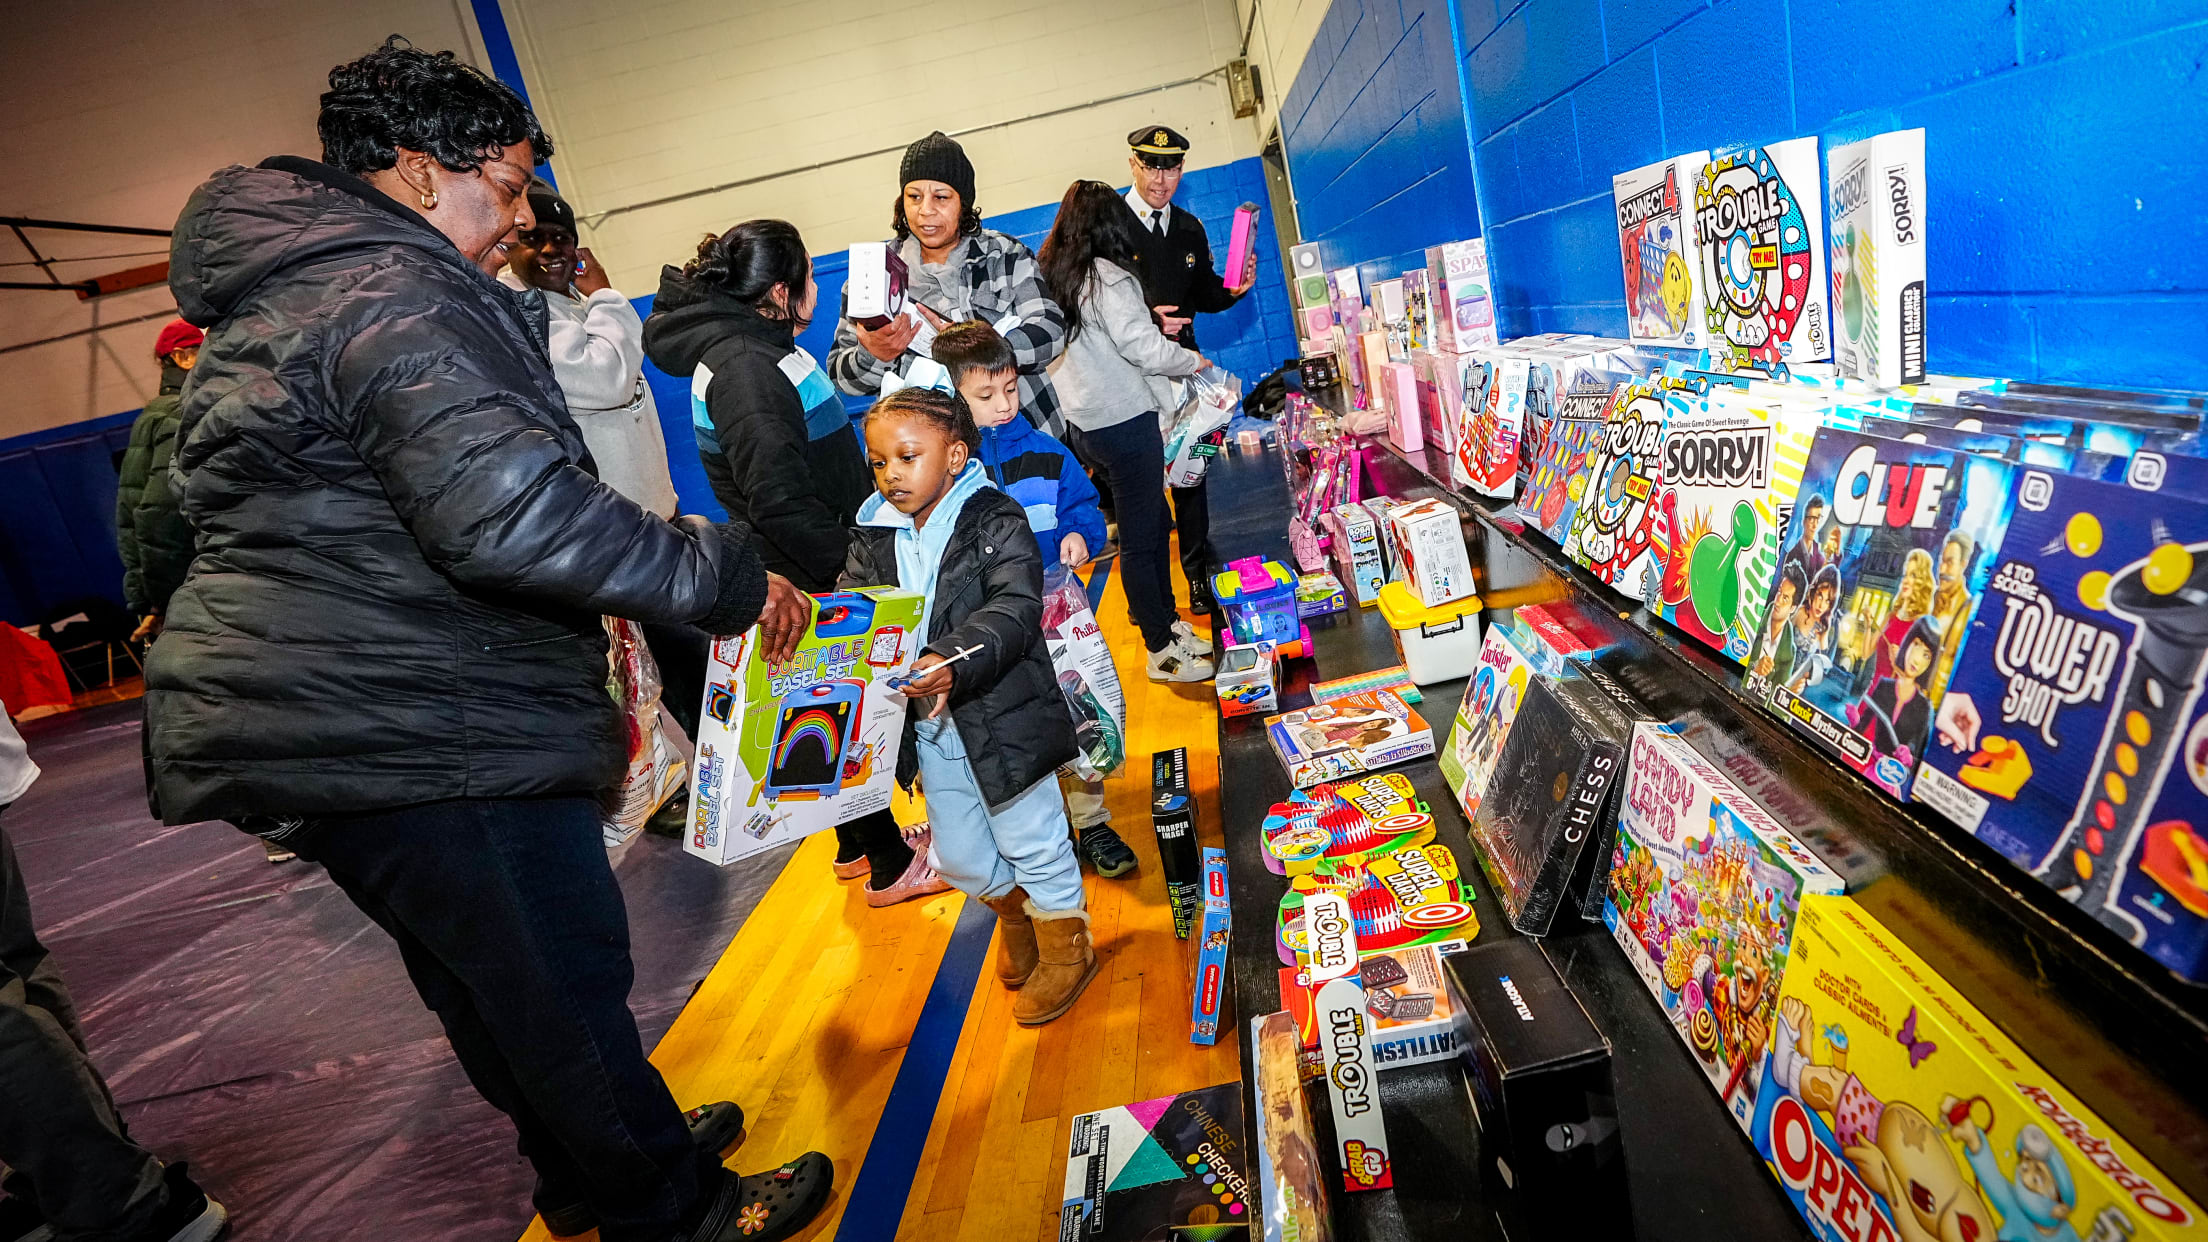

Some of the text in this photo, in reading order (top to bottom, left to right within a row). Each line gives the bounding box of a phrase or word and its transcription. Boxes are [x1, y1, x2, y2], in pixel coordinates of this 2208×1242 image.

[1620, 170, 1679, 226] CONNECT 4
[1835, 166, 1866, 216] SORRY!
[1888, 167, 1914, 243] SORRY!
[1697, 179, 1781, 244] TROUBLE
[1758, 220, 1776, 233] GAME
[1752, 251, 1774, 264] TRY ME!
[1807, 302, 1825, 355] TROUBLE
[1904, 290, 1913, 334] CLASSICS
[1905, 334, 1920, 377] MINI
[1561, 397, 1606, 417] CONNECT
[1692, 419, 1704, 428] Game
[1705, 418, 1711, 426] Of
[1712, 418, 1727, 427] Sweet
[1728, 417, 1749, 426] Revenge
[1602, 417, 1660, 456] TROUBL
[1666, 435, 1764, 480] SORRY!
[1628, 479, 1648, 496] TRY ME!
[1834, 445, 1947, 528] CLUE
[1994, 574, 2038, 599] SCORE
[2003, 562, 2034, 582] 4 TO
[766, 638, 865, 681] PORTABLE
[1481, 638, 1512, 673] Twister
[1996, 594, 2120, 704] TOWER
[770, 660, 858, 698] EASEL SET
[1592, 671, 1635, 705] CHESS
[1747, 677, 1756, 689] 8+
[750, 697, 788, 717] CHALKBOARD
[1556, 689, 1598, 728] CHESS
[1778, 690, 1865, 757] The Classic Mystery Game
[2003, 673, 2064, 748] SHOT
[1571, 726, 1584, 742] AGES
[1174, 748, 1184, 789] SHARPER IMAGE
[1634, 735, 1695, 816] CANDY
[694, 743, 714, 850] PORTABLE
[705, 751, 725, 847] EASEL SET
[1353, 794, 1390, 819] DARTS
[1360, 777, 1404, 806] SUPER
[1564, 755, 1612, 843] CHESS
[1630, 773, 1675, 843] LAND
[1689, 761, 1778, 834] CANDY LAND
[1156, 821, 1188, 834] SHARPER
[1162, 828, 1185, 840] IMAGE
[1625, 818, 1642, 840] Kingdom
[1645, 838, 1661, 850] Sweet
[1384, 872, 1427, 906] DARTS
[1395, 850, 1443, 890] SUPER
[1313, 901, 1348, 967] TROUBLE
[1866, 931, 1903, 965] CLASSIC
[1819, 968, 1851, 997] DOCTOR
[1852, 992, 1880, 1017] CARDS
[1844, 974, 1861, 992] WITH
[1900, 962, 1922, 984] THIS
[1920, 983, 1935, 997] IN
[1354, 1014, 1364, 1037] GAME
[1814, 977, 1892, 1039] CLASSIC AILMENTS!
[1934, 995, 1978, 1035] DOCTOR
[1330, 1007, 1371, 1118] TROUBLE
[1976, 1033, 2000, 1056] THE
[1092, 1113, 1100, 1126] ONE
[1184, 1099, 1237, 1154] CHINESE
[1097, 1157, 1105, 1180] WOODEN
[1349, 1144, 1363, 1177] GRAB
[1360, 1151, 1381, 1186] & GO
[2014, 1082, 2193, 1226] OPERATION
[1197, 1142, 1249, 1206] CHECKERS
[1094, 1182, 1103, 1206] CLASSIC
